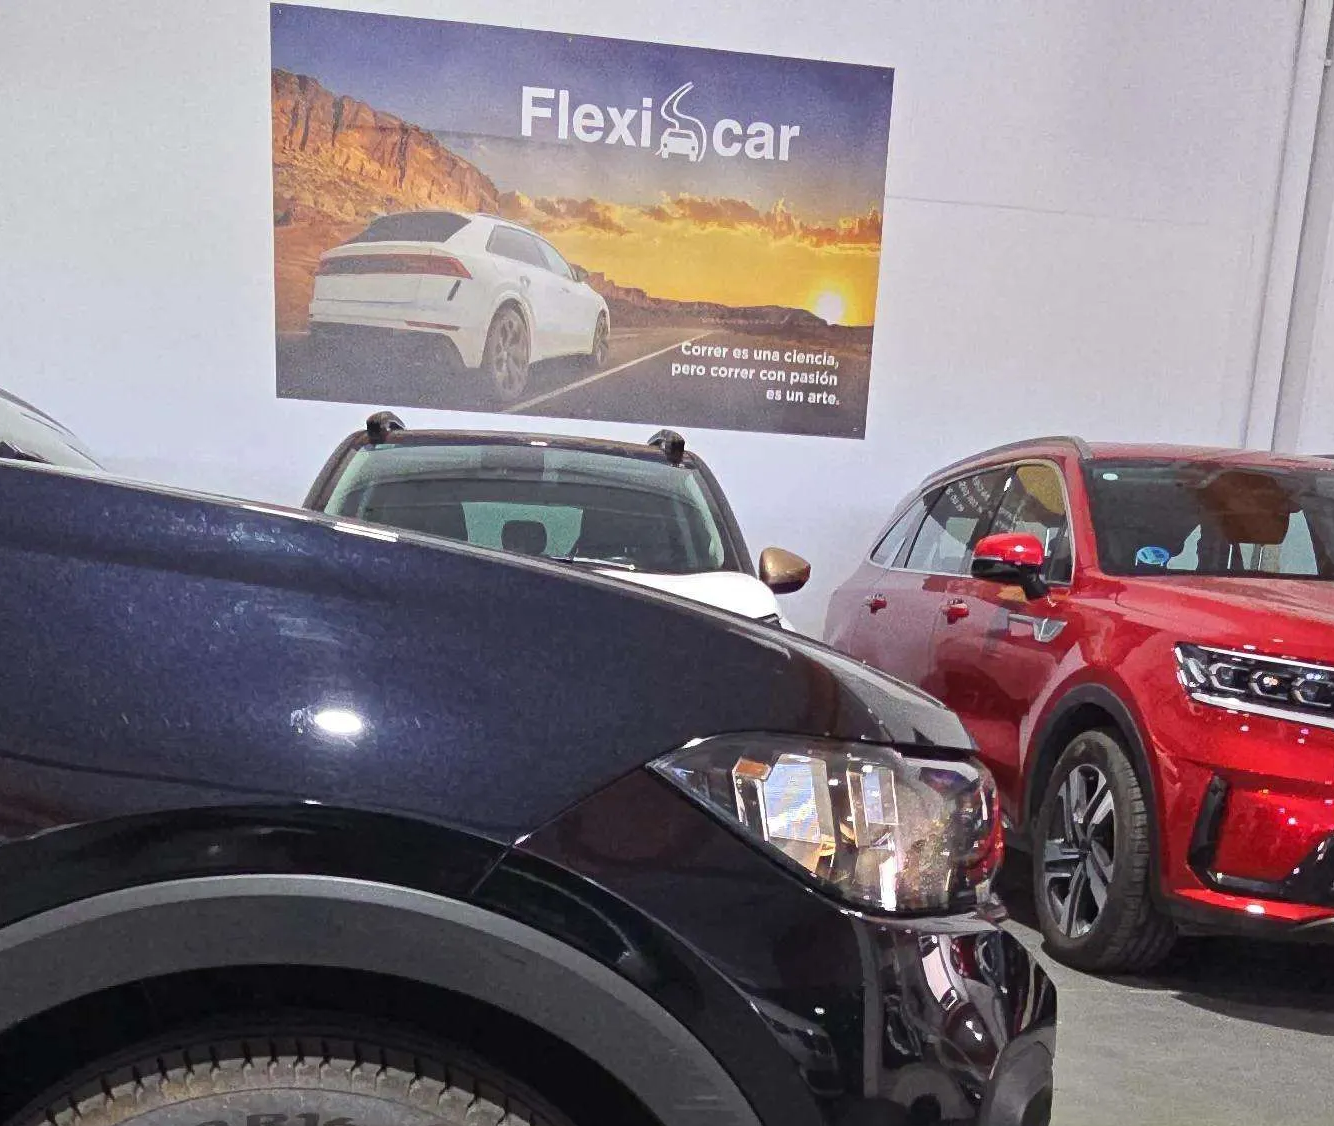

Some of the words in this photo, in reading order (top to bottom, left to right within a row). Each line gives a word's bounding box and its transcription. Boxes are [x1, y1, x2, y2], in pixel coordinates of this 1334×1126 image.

[681, 342, 728, 359] Correr
[733, 349, 748, 360] es
[754, 349, 780, 362] una
[784, 349, 839, 369] ciencia,
[671, 362, 706, 376] pero
[710, 366, 755, 380] correr
[759, 369, 786, 382] con
[790, 371, 838, 387] pasión
[767, 389, 782, 401] es
[786, 390, 804, 403] un
[807, 391, 840, 406] arte.
